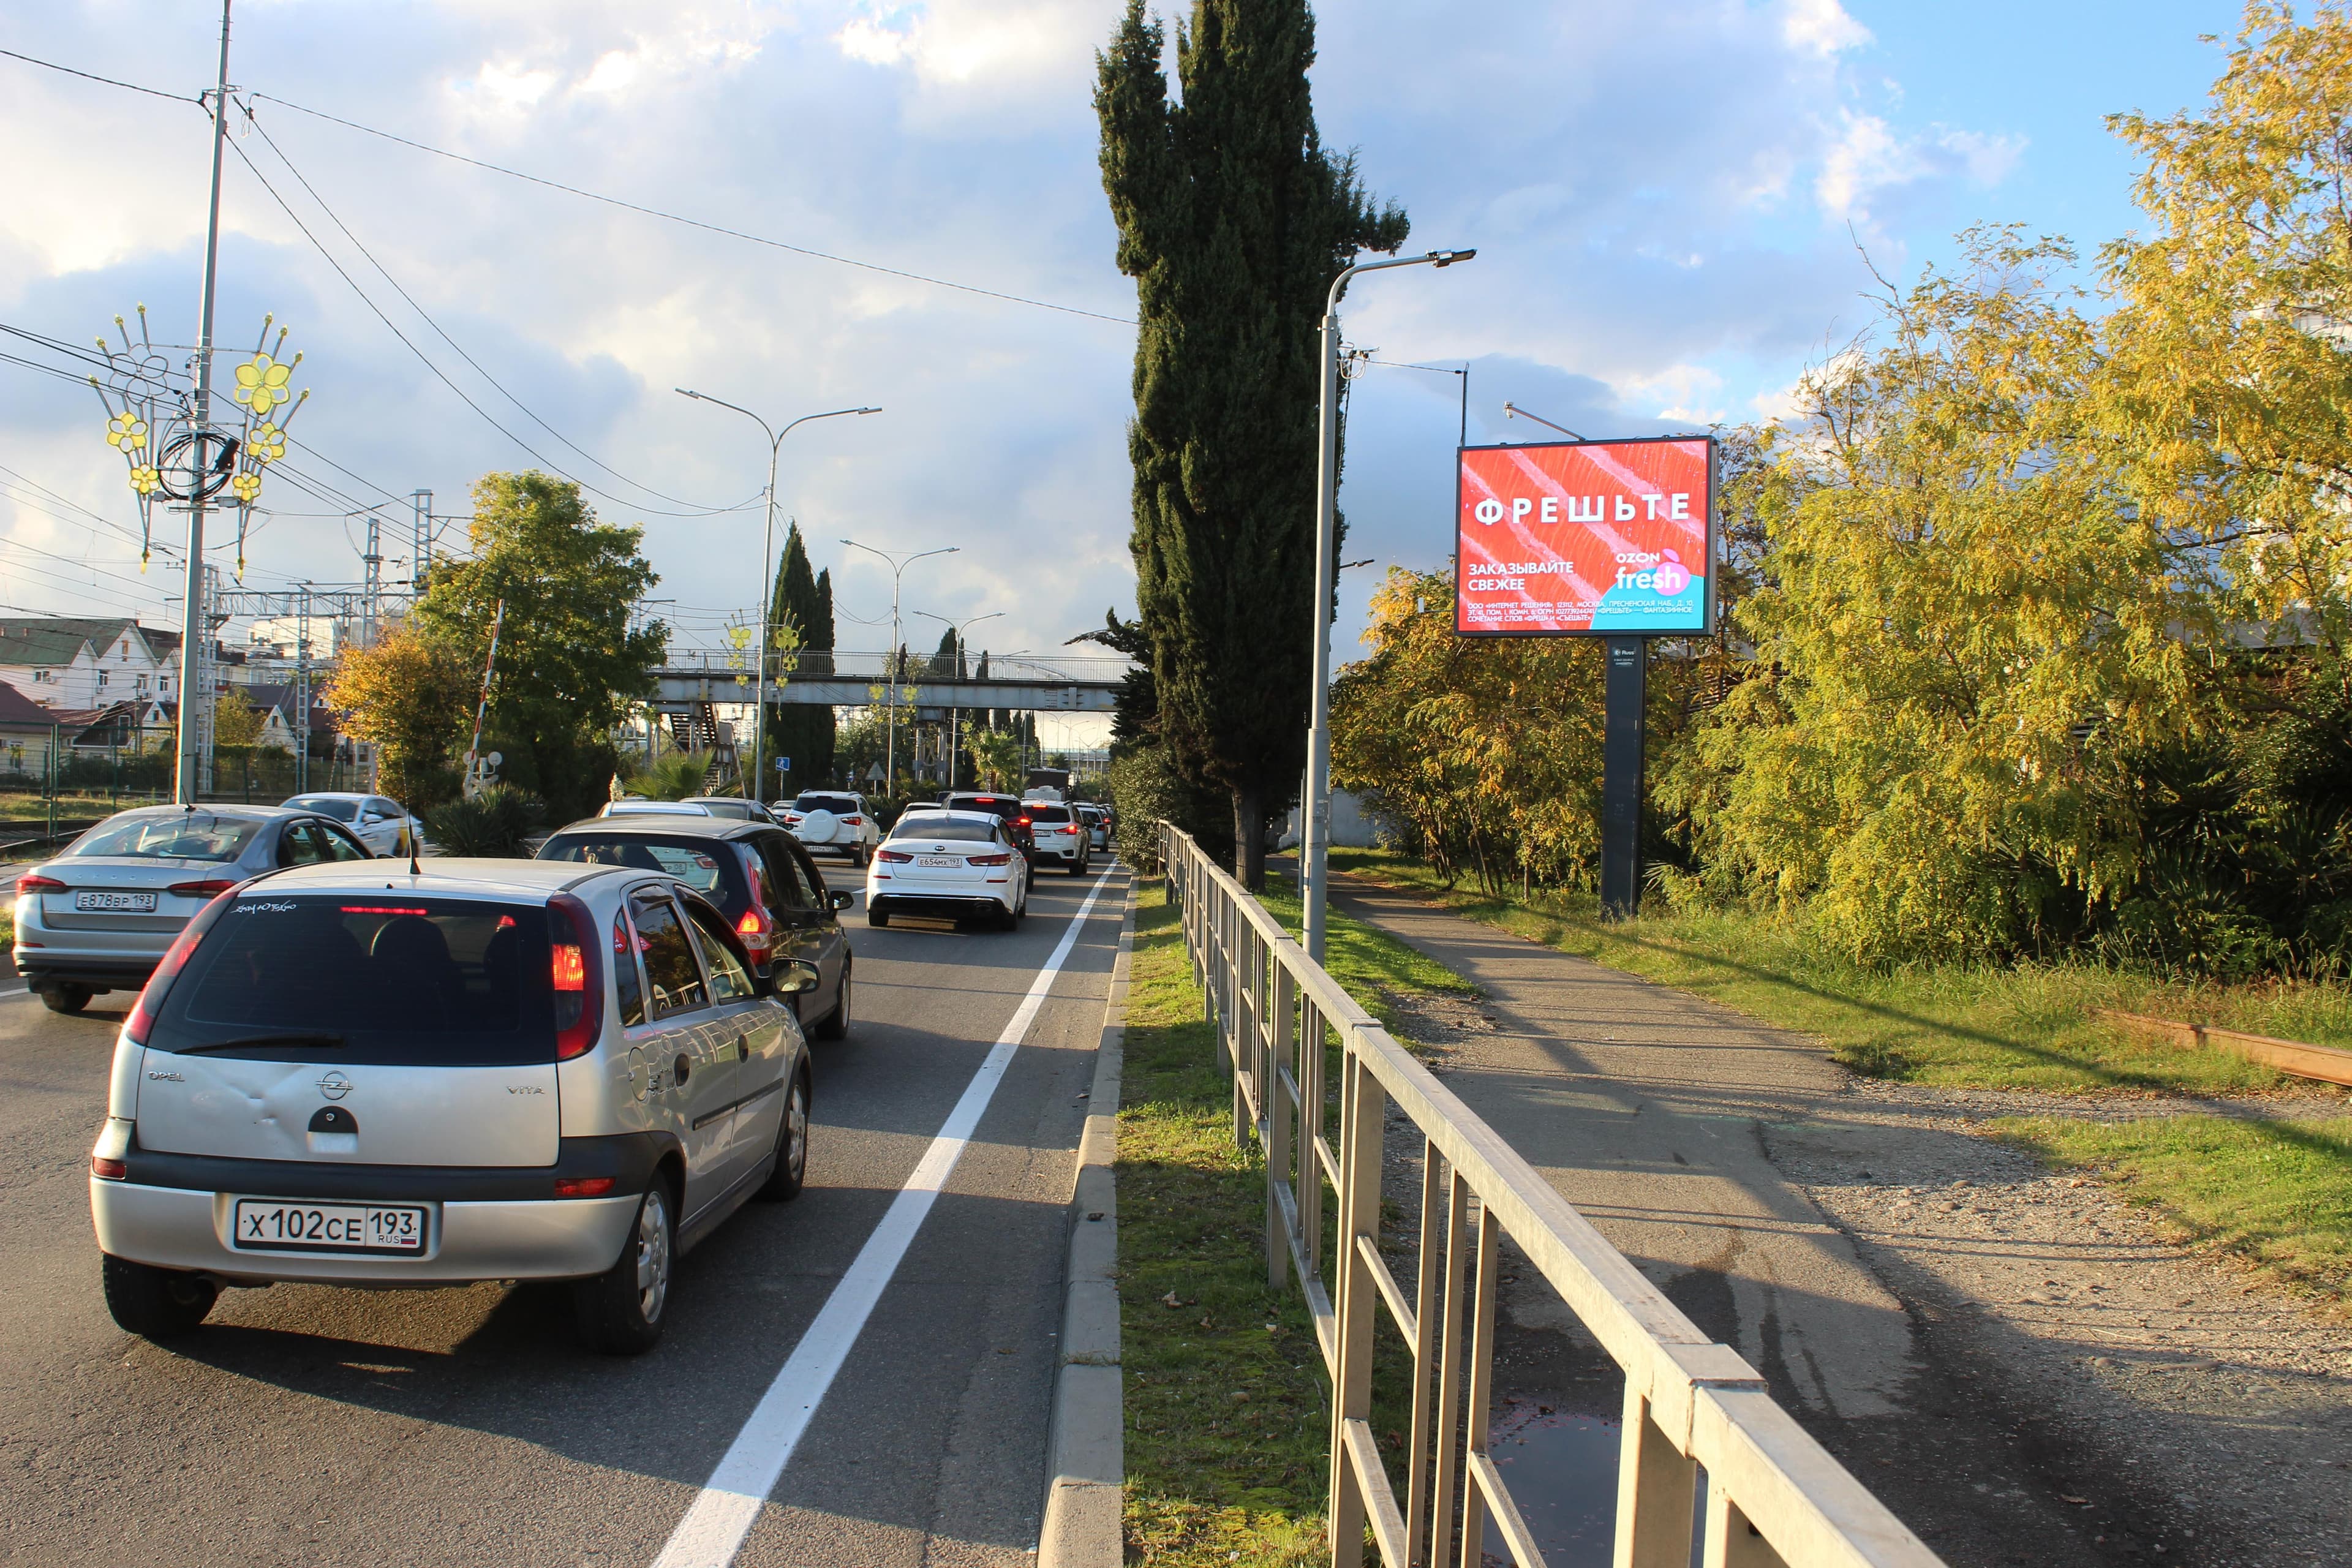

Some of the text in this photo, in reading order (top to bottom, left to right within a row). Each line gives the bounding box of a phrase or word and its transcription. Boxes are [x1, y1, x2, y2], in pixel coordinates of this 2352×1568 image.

[1474, 492, 1690, 526] ФРЕШЬТЕ
[1616, 552, 1660, 564] OZON
[1468, 560, 1574, 575] ЗАКАЗЫВАЙТЕ
[1615, 565, 1681, 590] fresh
[1468, 579, 1525, 592] СВЕЖЕЕ
[81, 894, 152, 907] Е878ВР 193
[148, 1071, 185, 1082] OPEL
[507, 1086, 545, 1095] VITA
[248, 1208, 413, 1242] Х102СЕ 193
[378, 1235, 399, 1244] RUS
